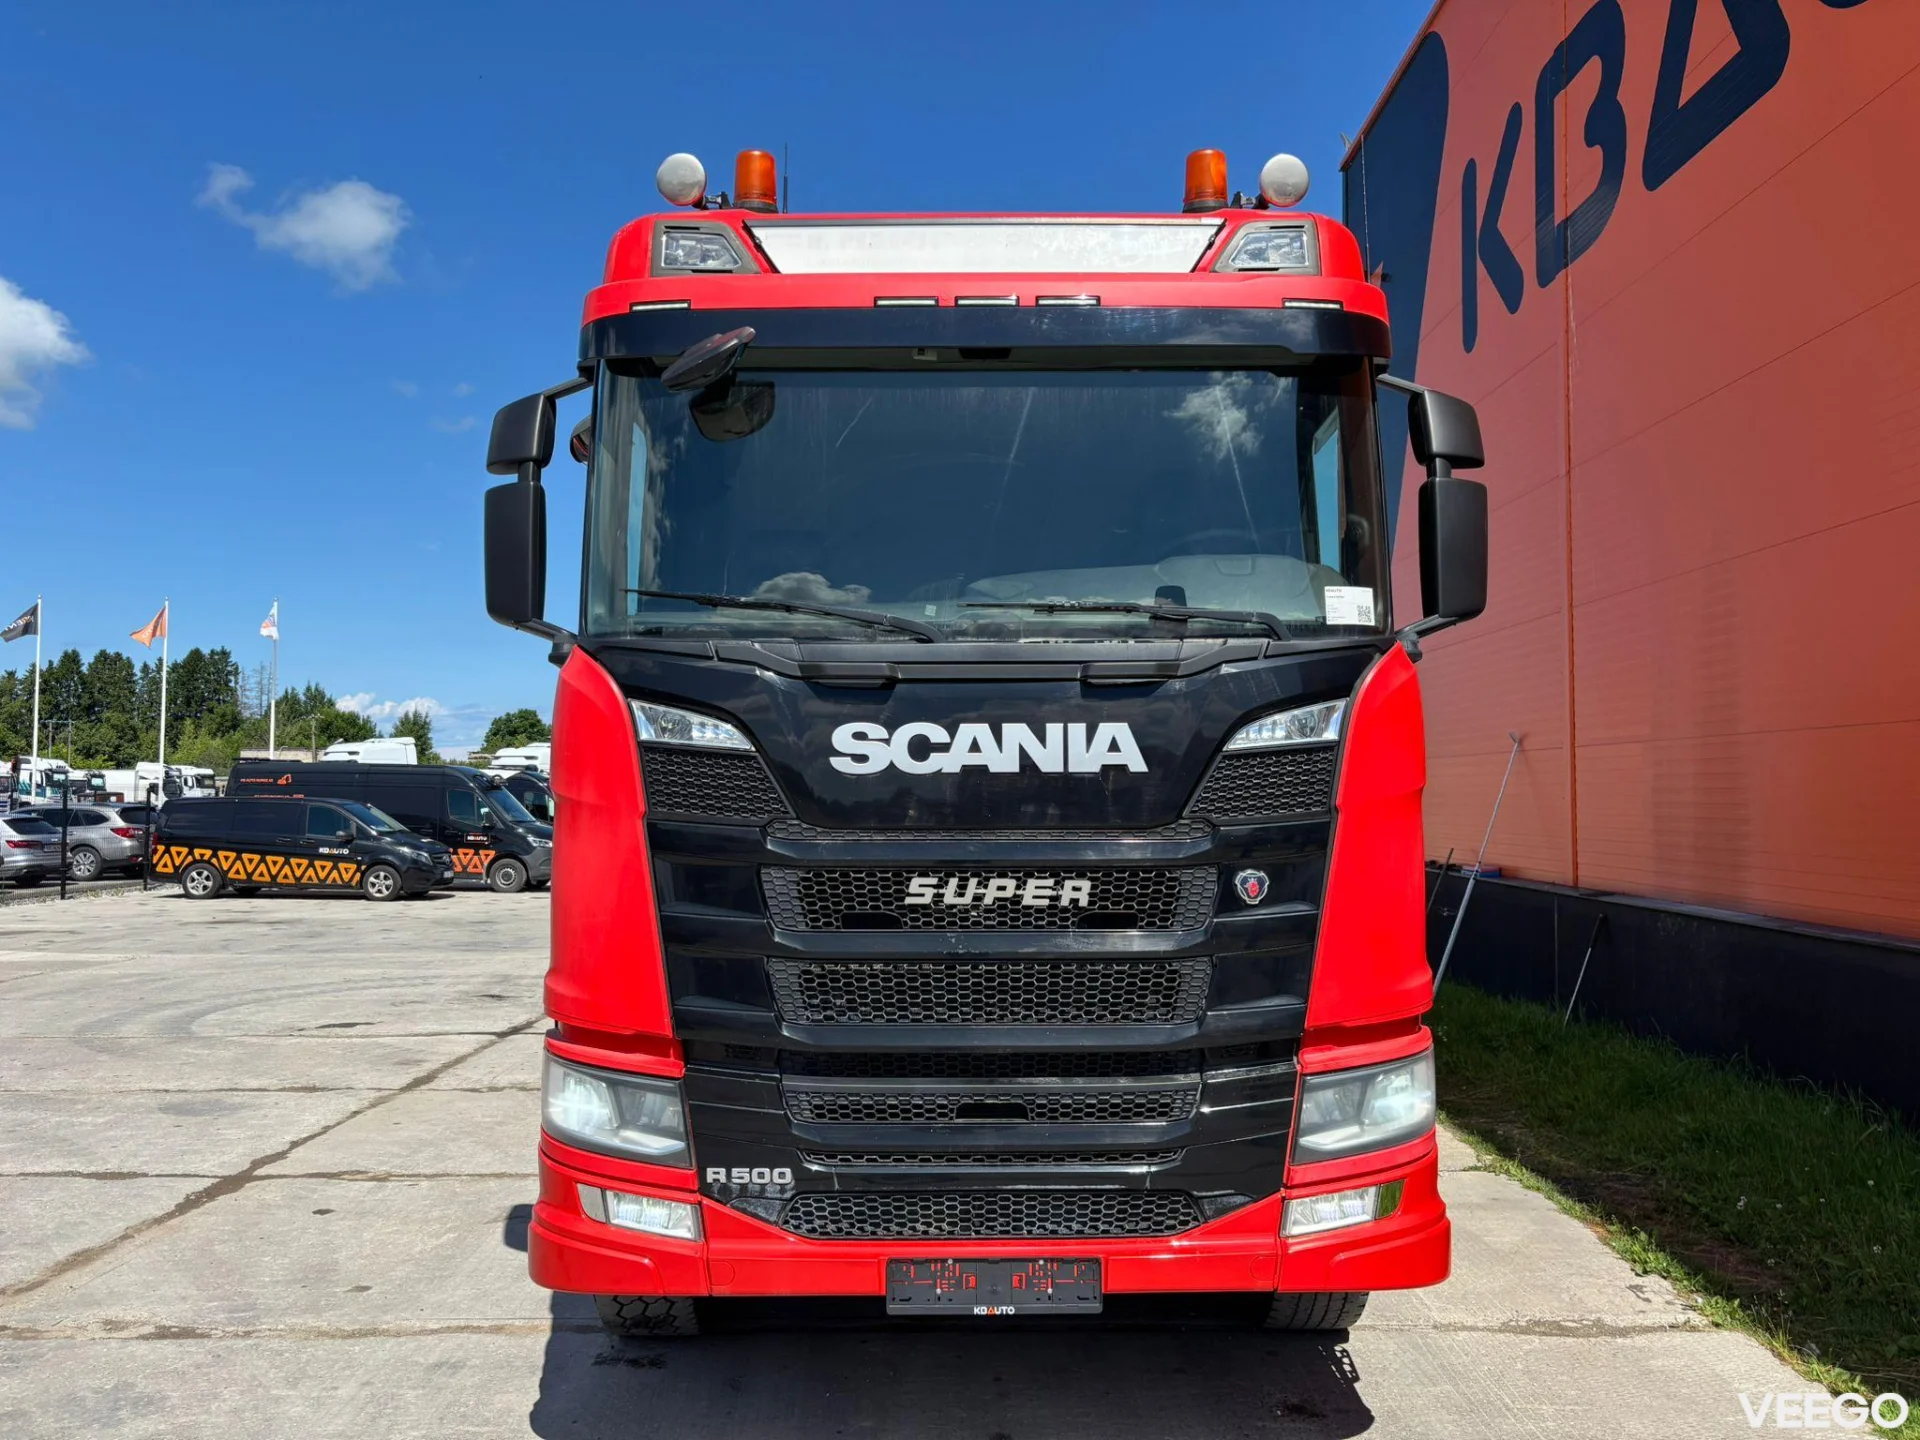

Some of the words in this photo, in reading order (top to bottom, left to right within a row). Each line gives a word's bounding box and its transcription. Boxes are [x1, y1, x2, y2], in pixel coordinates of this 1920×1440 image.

[1461, 0, 1867, 353] KBA
[829, 722, 1149, 774] SCANIA
[905, 877, 1092, 907] SUPER
